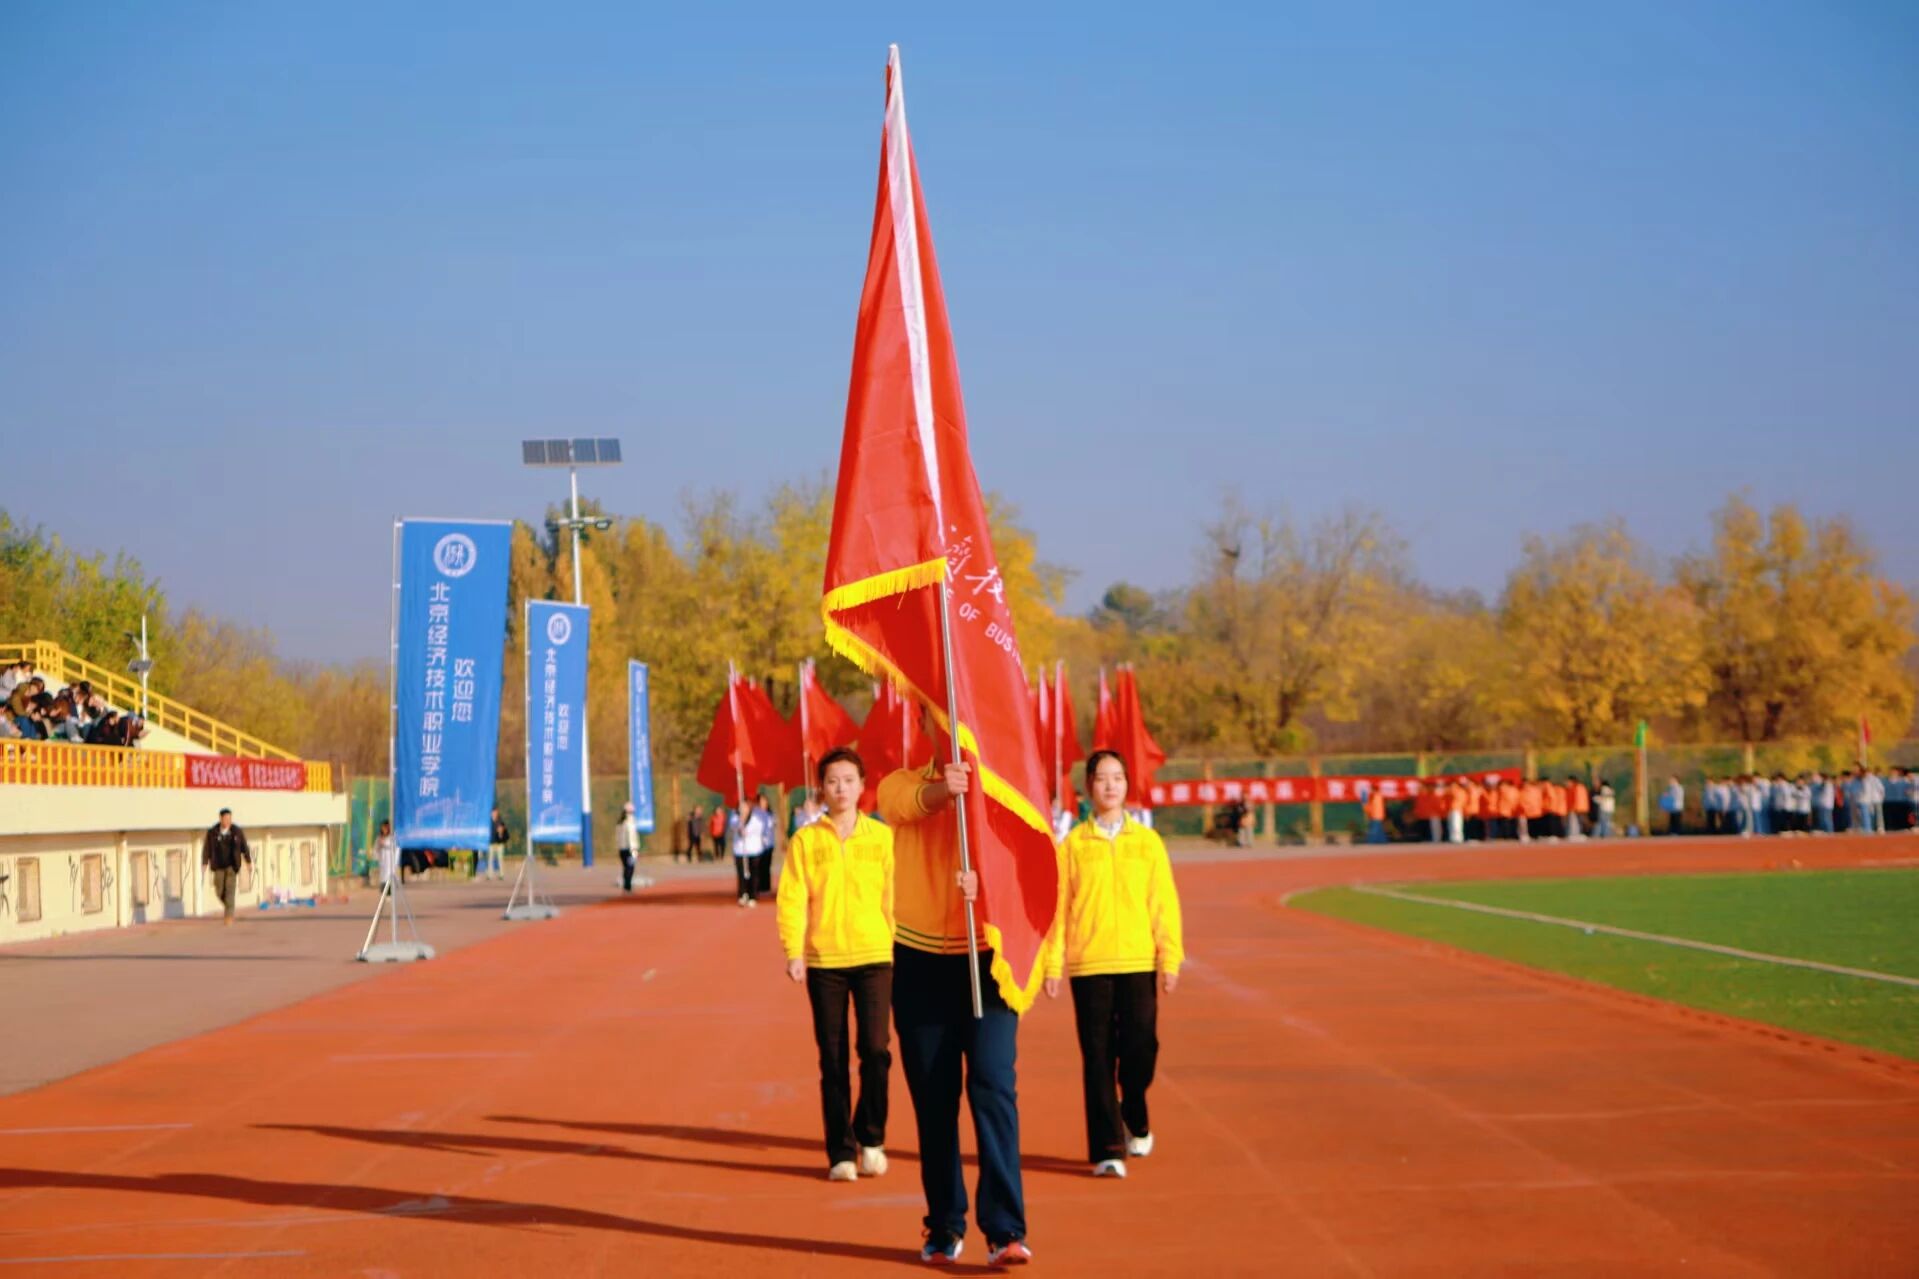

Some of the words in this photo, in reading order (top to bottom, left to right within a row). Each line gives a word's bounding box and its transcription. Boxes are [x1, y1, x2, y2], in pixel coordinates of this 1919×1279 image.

[958, 602, 981, 622] OF
[419, 581, 451, 798] 北京经济技术职业学院
[451, 657, 475, 722] 欢迎您
